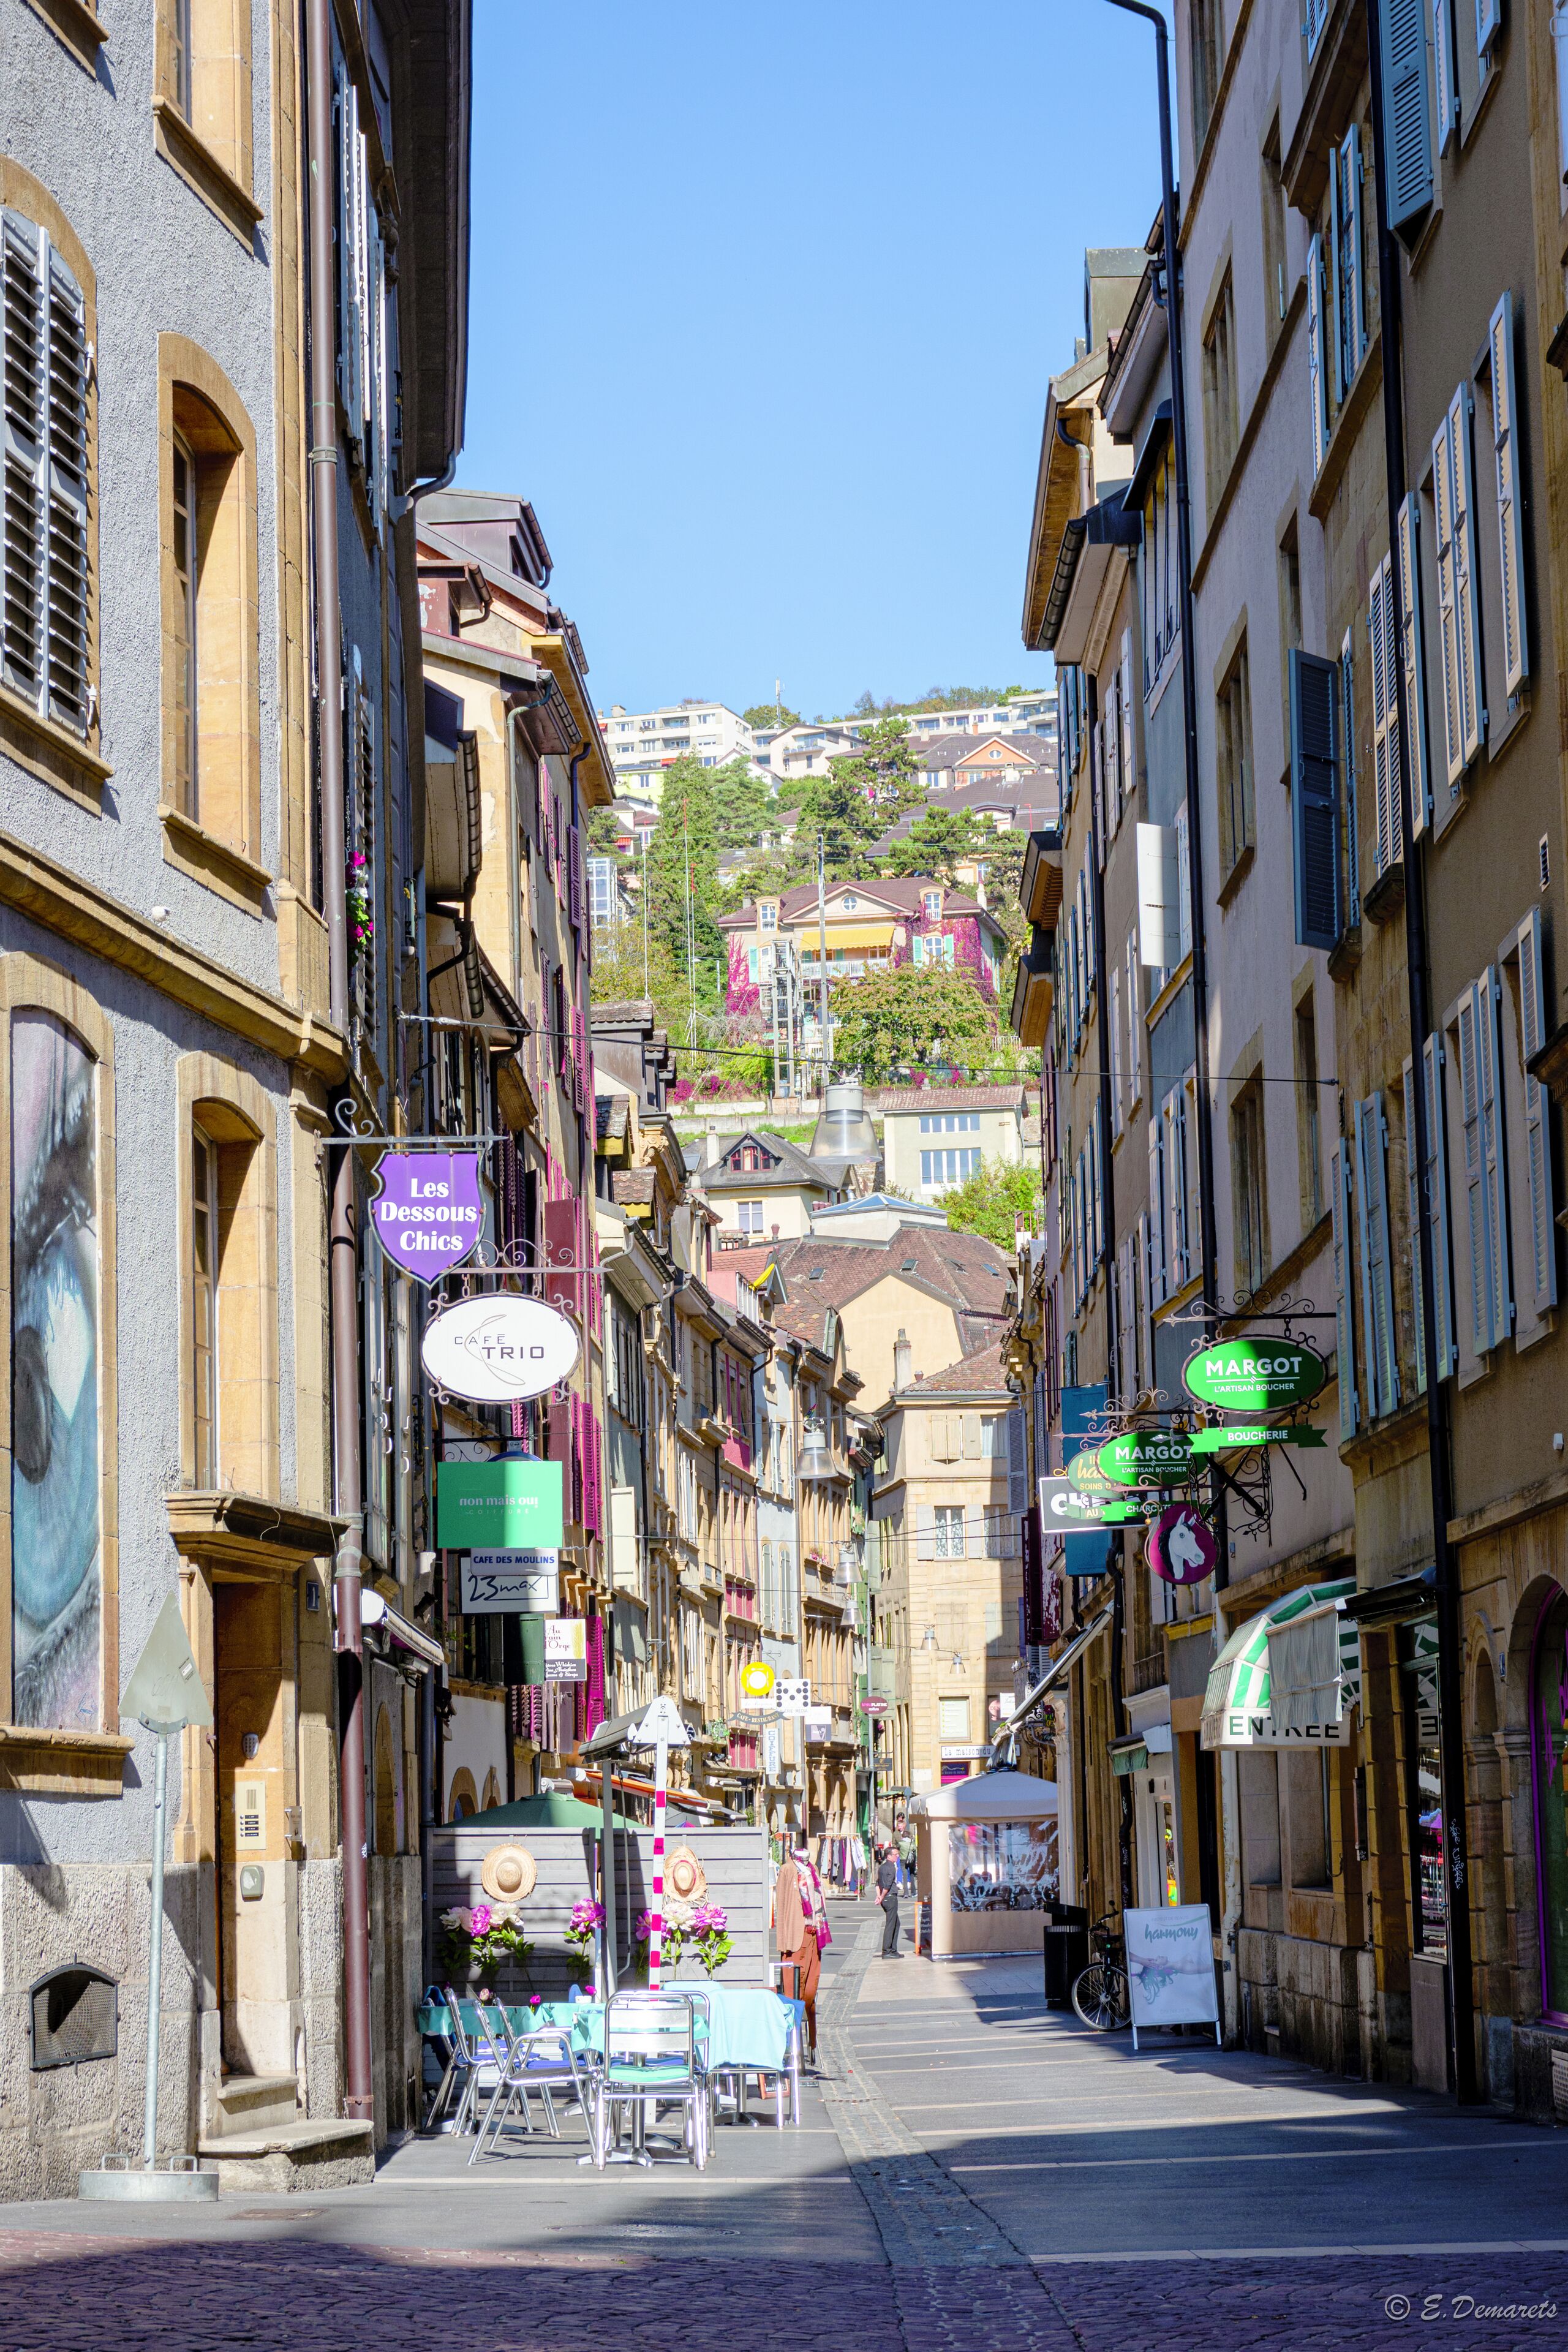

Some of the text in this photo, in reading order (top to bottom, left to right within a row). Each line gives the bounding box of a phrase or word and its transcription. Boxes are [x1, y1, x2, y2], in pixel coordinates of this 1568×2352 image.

[410, 1178, 449, 1198] Les
[380, 1202, 477, 1222] Dessous
[399, 1231, 463, 1251] Chics
[482, 1346, 545, 1360] TRIO
[1205, 1357, 1302, 1377] MARGOT
[1214, 1384, 1254, 1393] L'ARTISAN
[1227, 1430, 1288, 1441] BOUCHERIE
[1115, 1446, 1192, 1460] MARGOT
[459, 1498, 483, 1506] non
[486, 1494, 515, 1506] mais
[548, 1625, 560, 1635] Au
[1229, 1716, 1340, 1738] ENEE
[944, 1747, 952, 1756] La
[982, 1746, 991, 1755] du
[1144, 1923, 1199, 1943] harmony
